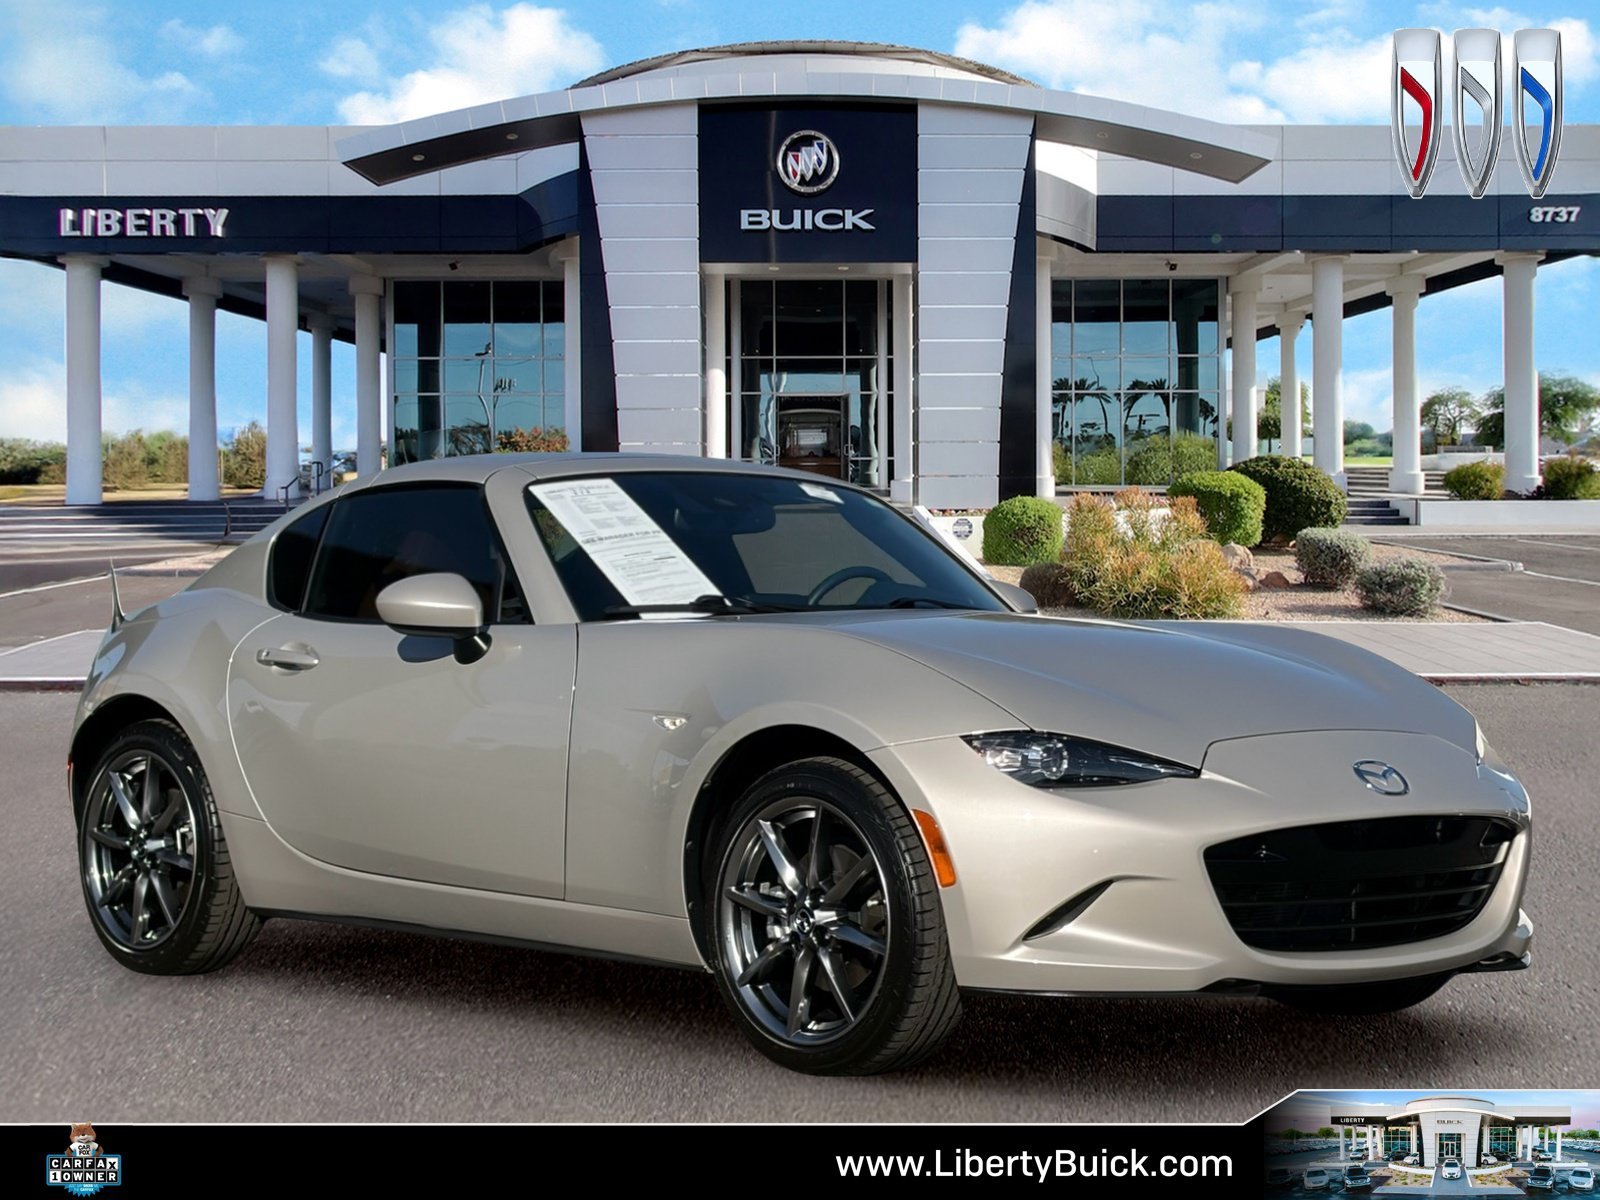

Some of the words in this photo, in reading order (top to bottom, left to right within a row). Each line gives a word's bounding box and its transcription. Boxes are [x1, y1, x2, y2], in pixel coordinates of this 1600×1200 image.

[59, 207, 229, 237] LIBERTY
[740, 208, 876, 230] BUICK
[1529, 206, 1580, 222] 8737
